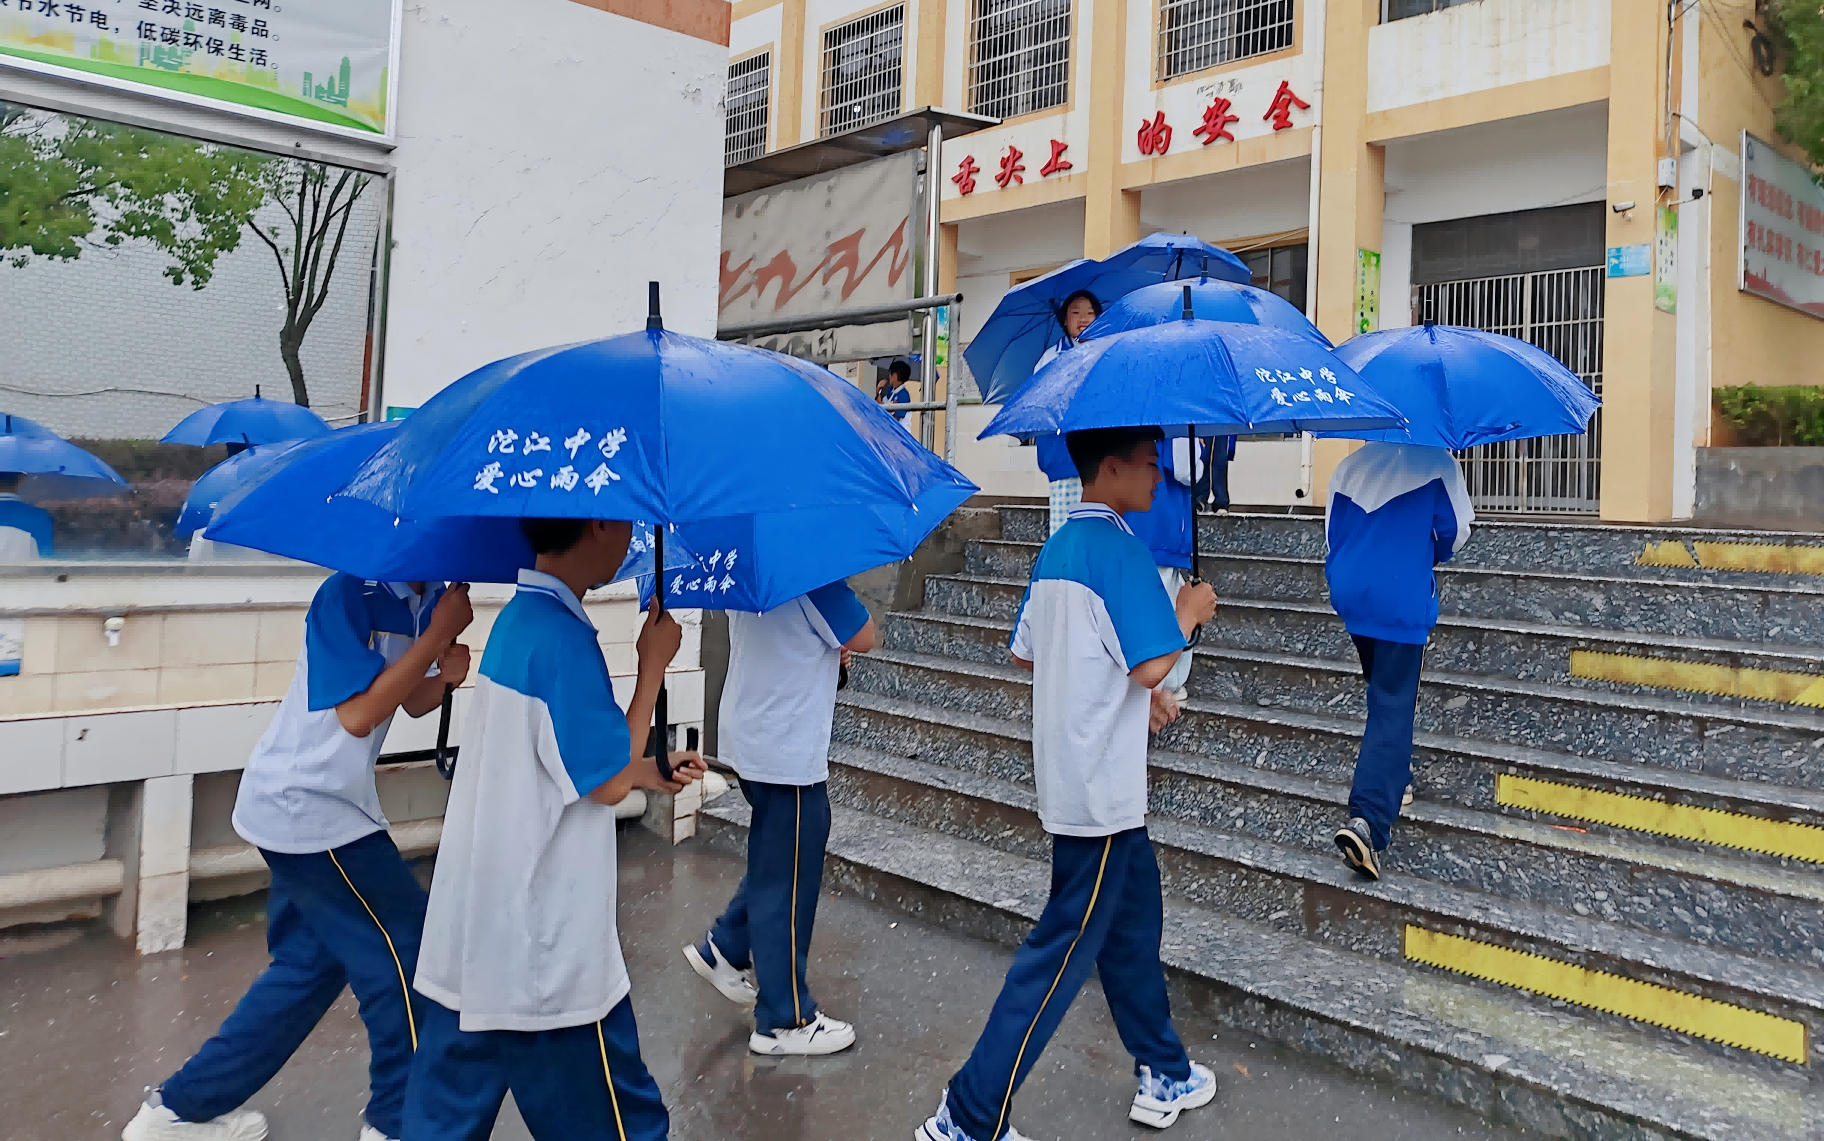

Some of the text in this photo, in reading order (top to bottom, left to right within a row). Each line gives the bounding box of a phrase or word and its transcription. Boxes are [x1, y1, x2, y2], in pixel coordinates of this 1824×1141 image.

[951, 80, 1311, 196] 舌尖上 的安全
[487, 426, 628, 460] 沱江中学
[473, 460, 621, 497] 爱心雨伞
